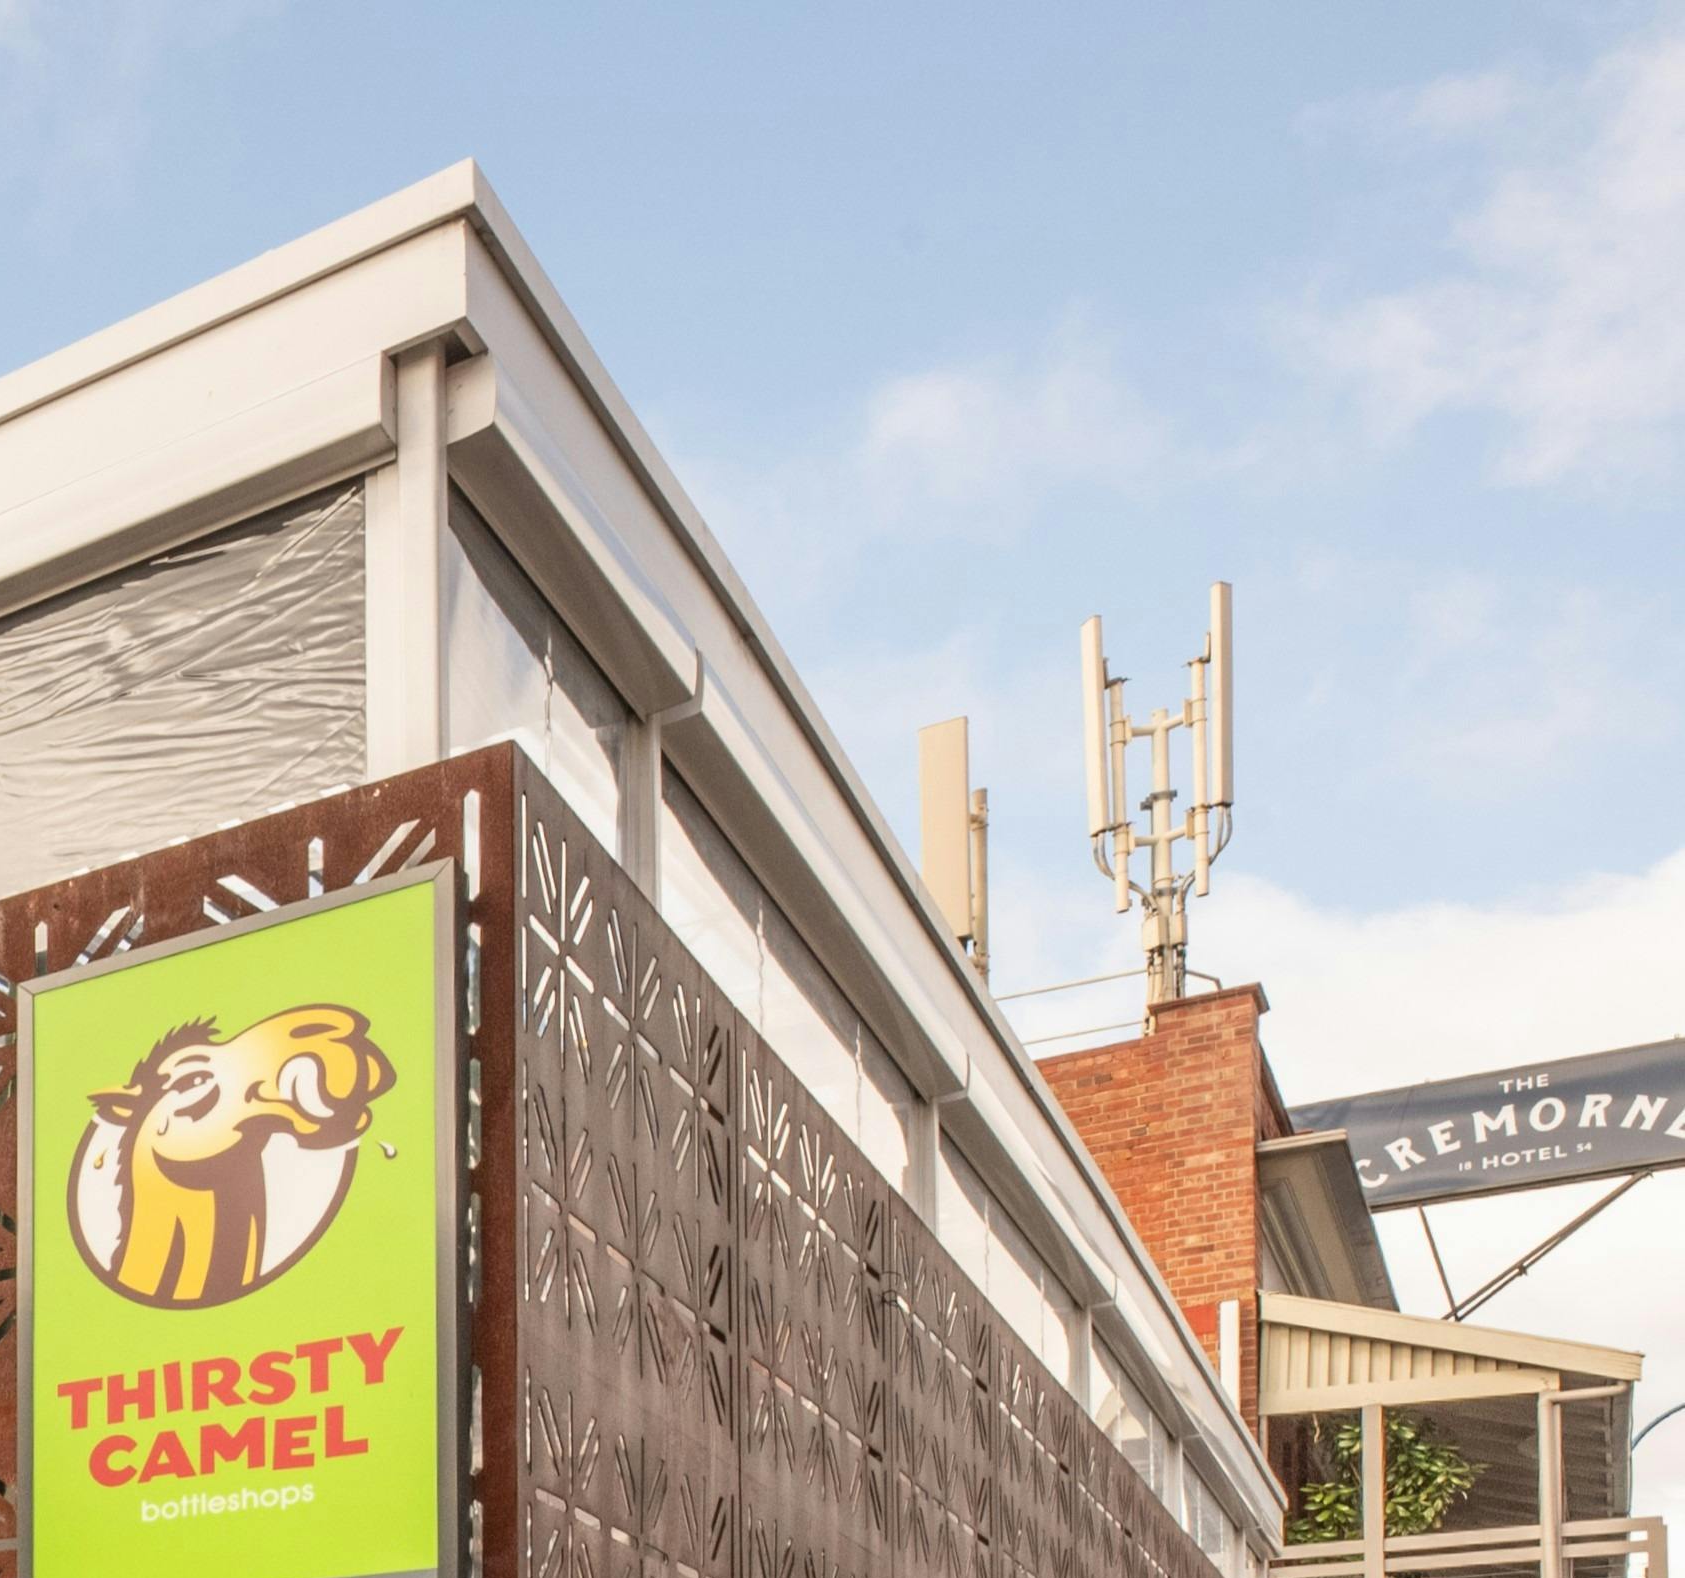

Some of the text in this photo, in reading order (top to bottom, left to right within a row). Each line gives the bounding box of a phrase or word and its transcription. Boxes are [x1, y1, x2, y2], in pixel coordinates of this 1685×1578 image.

[1498, 1073, 1550, 1094] THE
[1458, 1142, 1593, 1171] 18 HOTEL 54
[57, 1326, 405, 1431] THIRSTY
[87, 1406, 369, 1488] CAMEL
[140, 1479, 315, 1524] bottleshops
